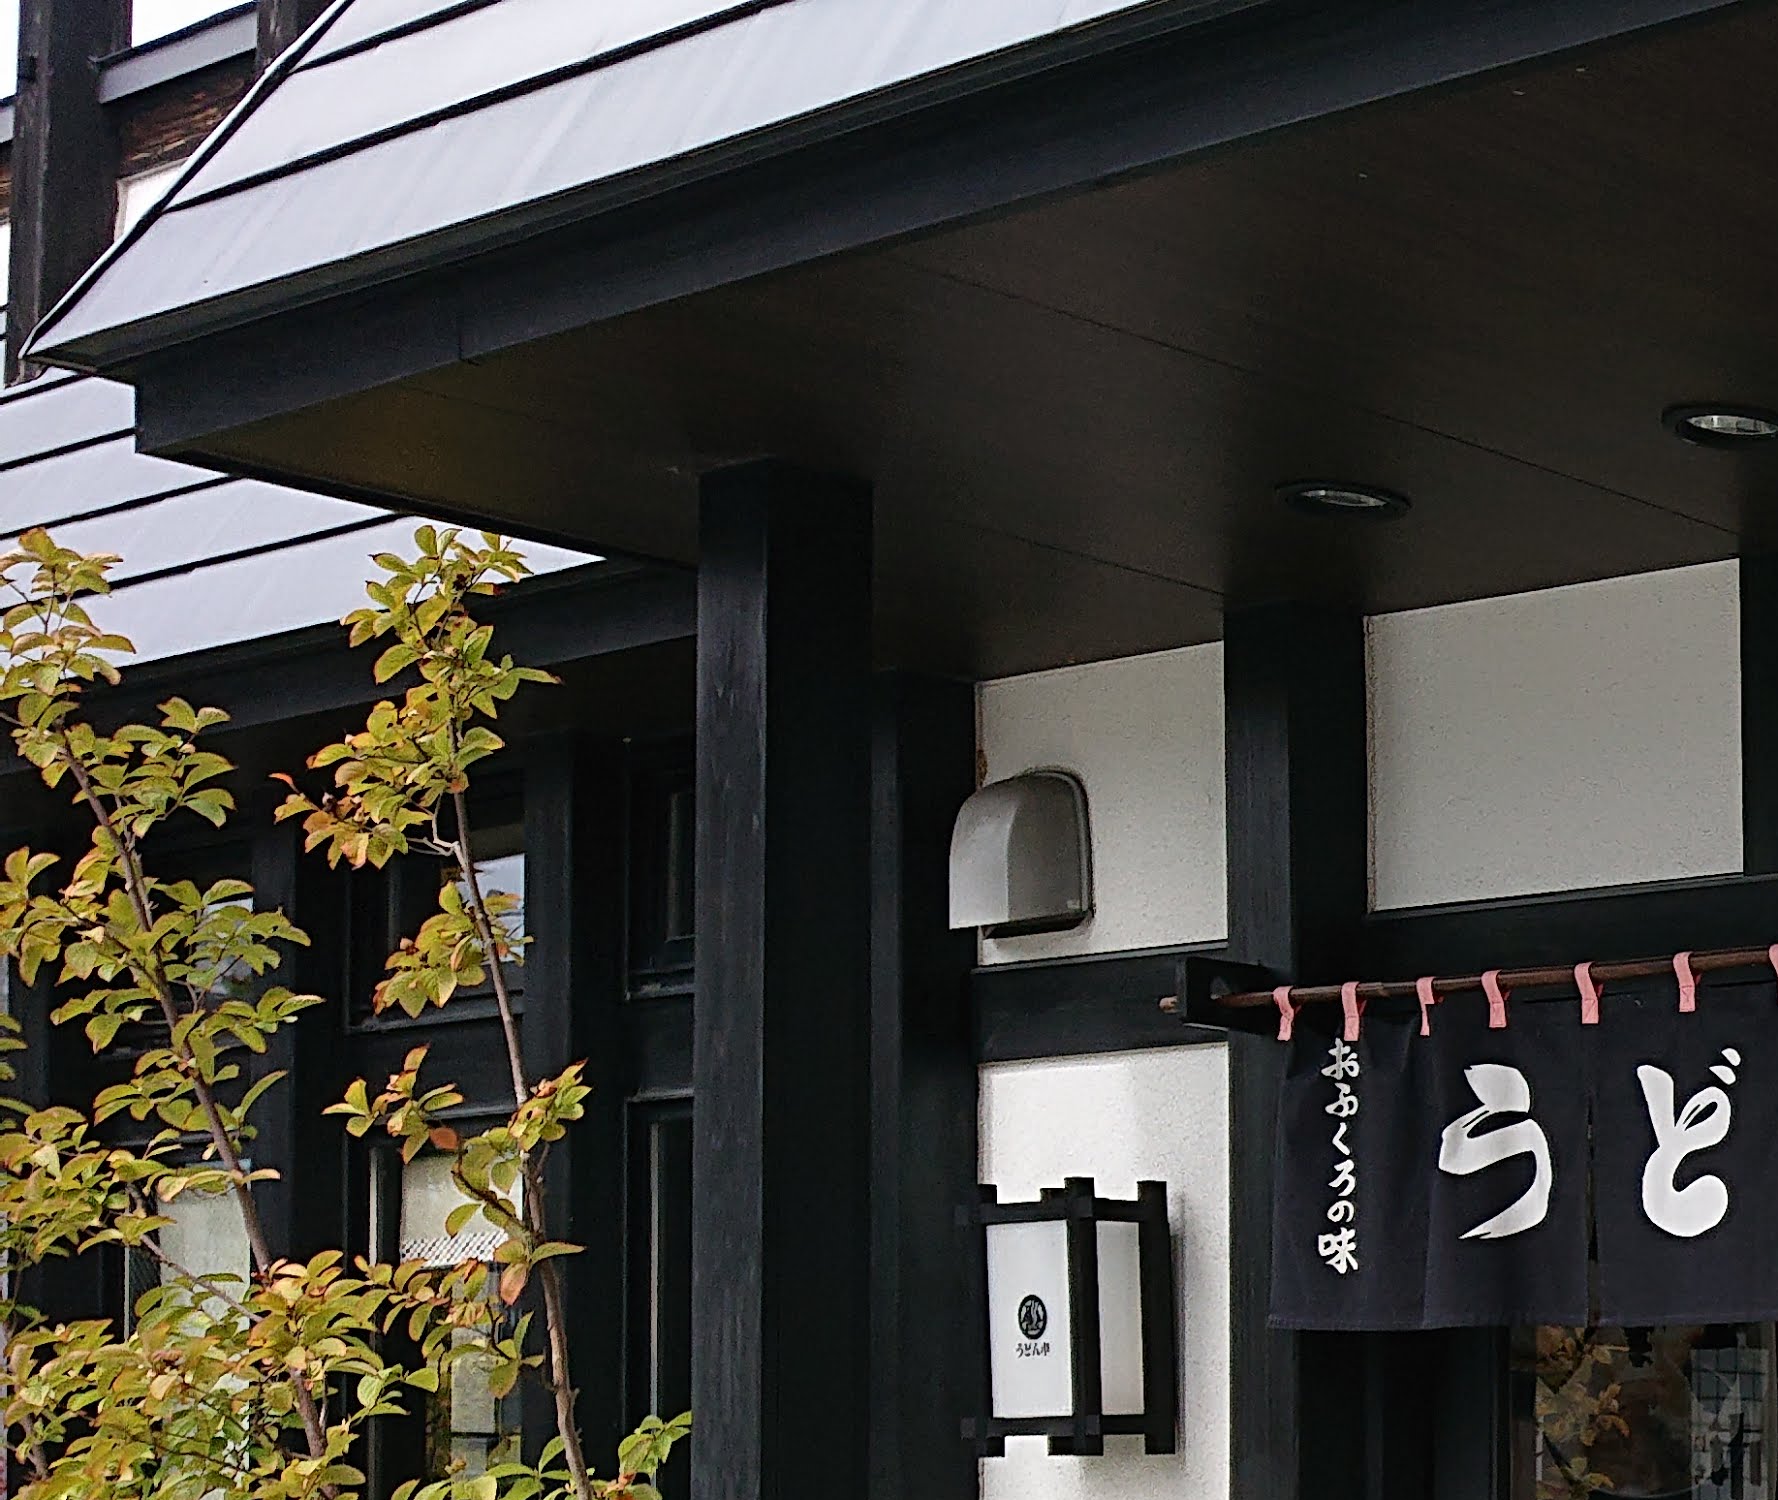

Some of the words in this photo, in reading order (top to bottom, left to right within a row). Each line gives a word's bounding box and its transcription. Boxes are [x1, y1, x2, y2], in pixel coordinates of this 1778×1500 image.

[1317, 1037, 1360, 1275] おふくろの味
[1015, 1342, 1050, 1359] うどん市
